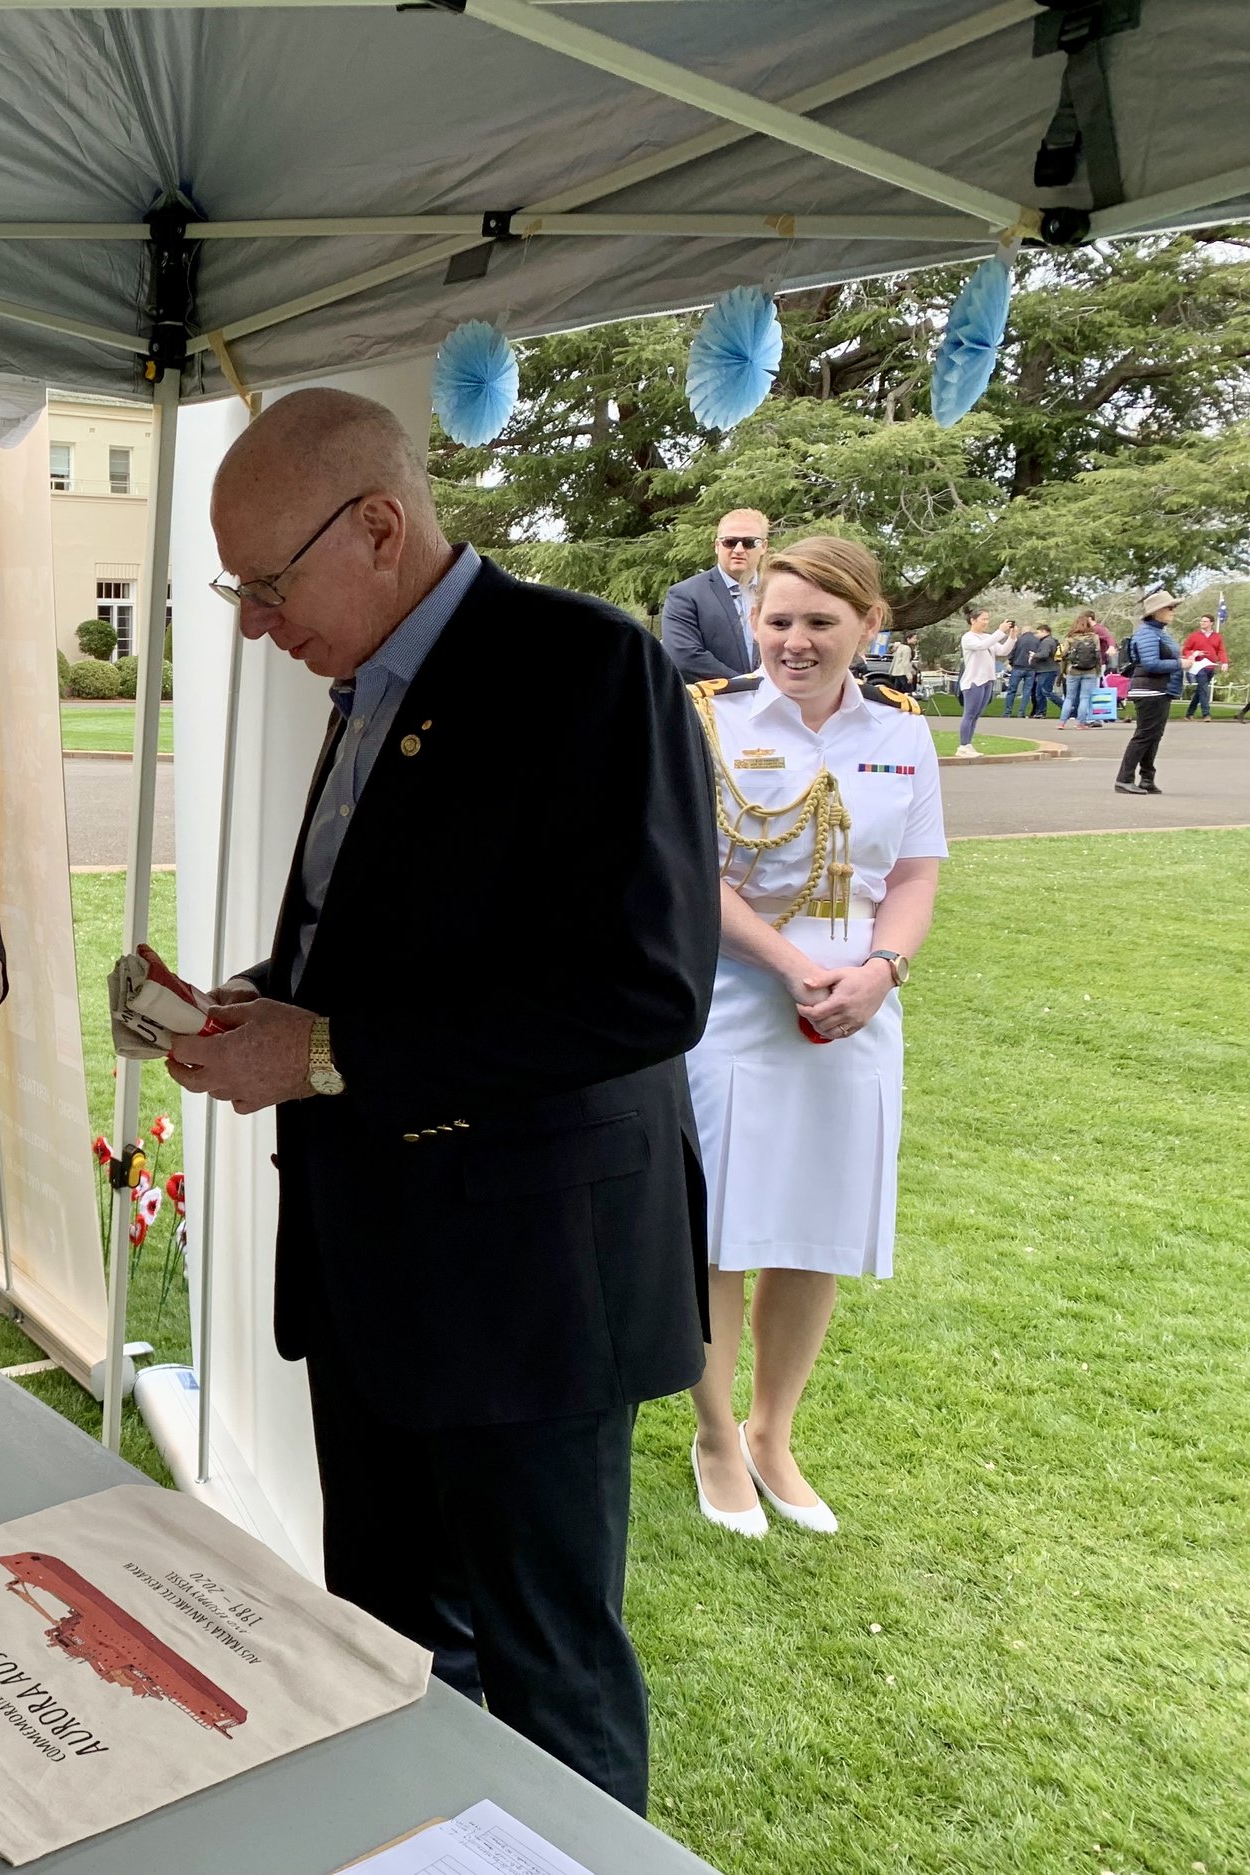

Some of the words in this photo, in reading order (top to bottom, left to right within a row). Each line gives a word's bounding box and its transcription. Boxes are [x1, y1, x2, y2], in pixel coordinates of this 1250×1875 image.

[124, 1563, 163, 1590] RESEARCH
[165, 1572, 193, 1592] VESSEL
[190, 1573, 224, 1593] 2020
[160, 1589, 208, 1623] ANTARCTIC
[229, 1604, 262, 1626] 1989
[205, 1622, 259, 1663] AUSTRALIA'S
[17, 1683, 109, 1755] AURORA
